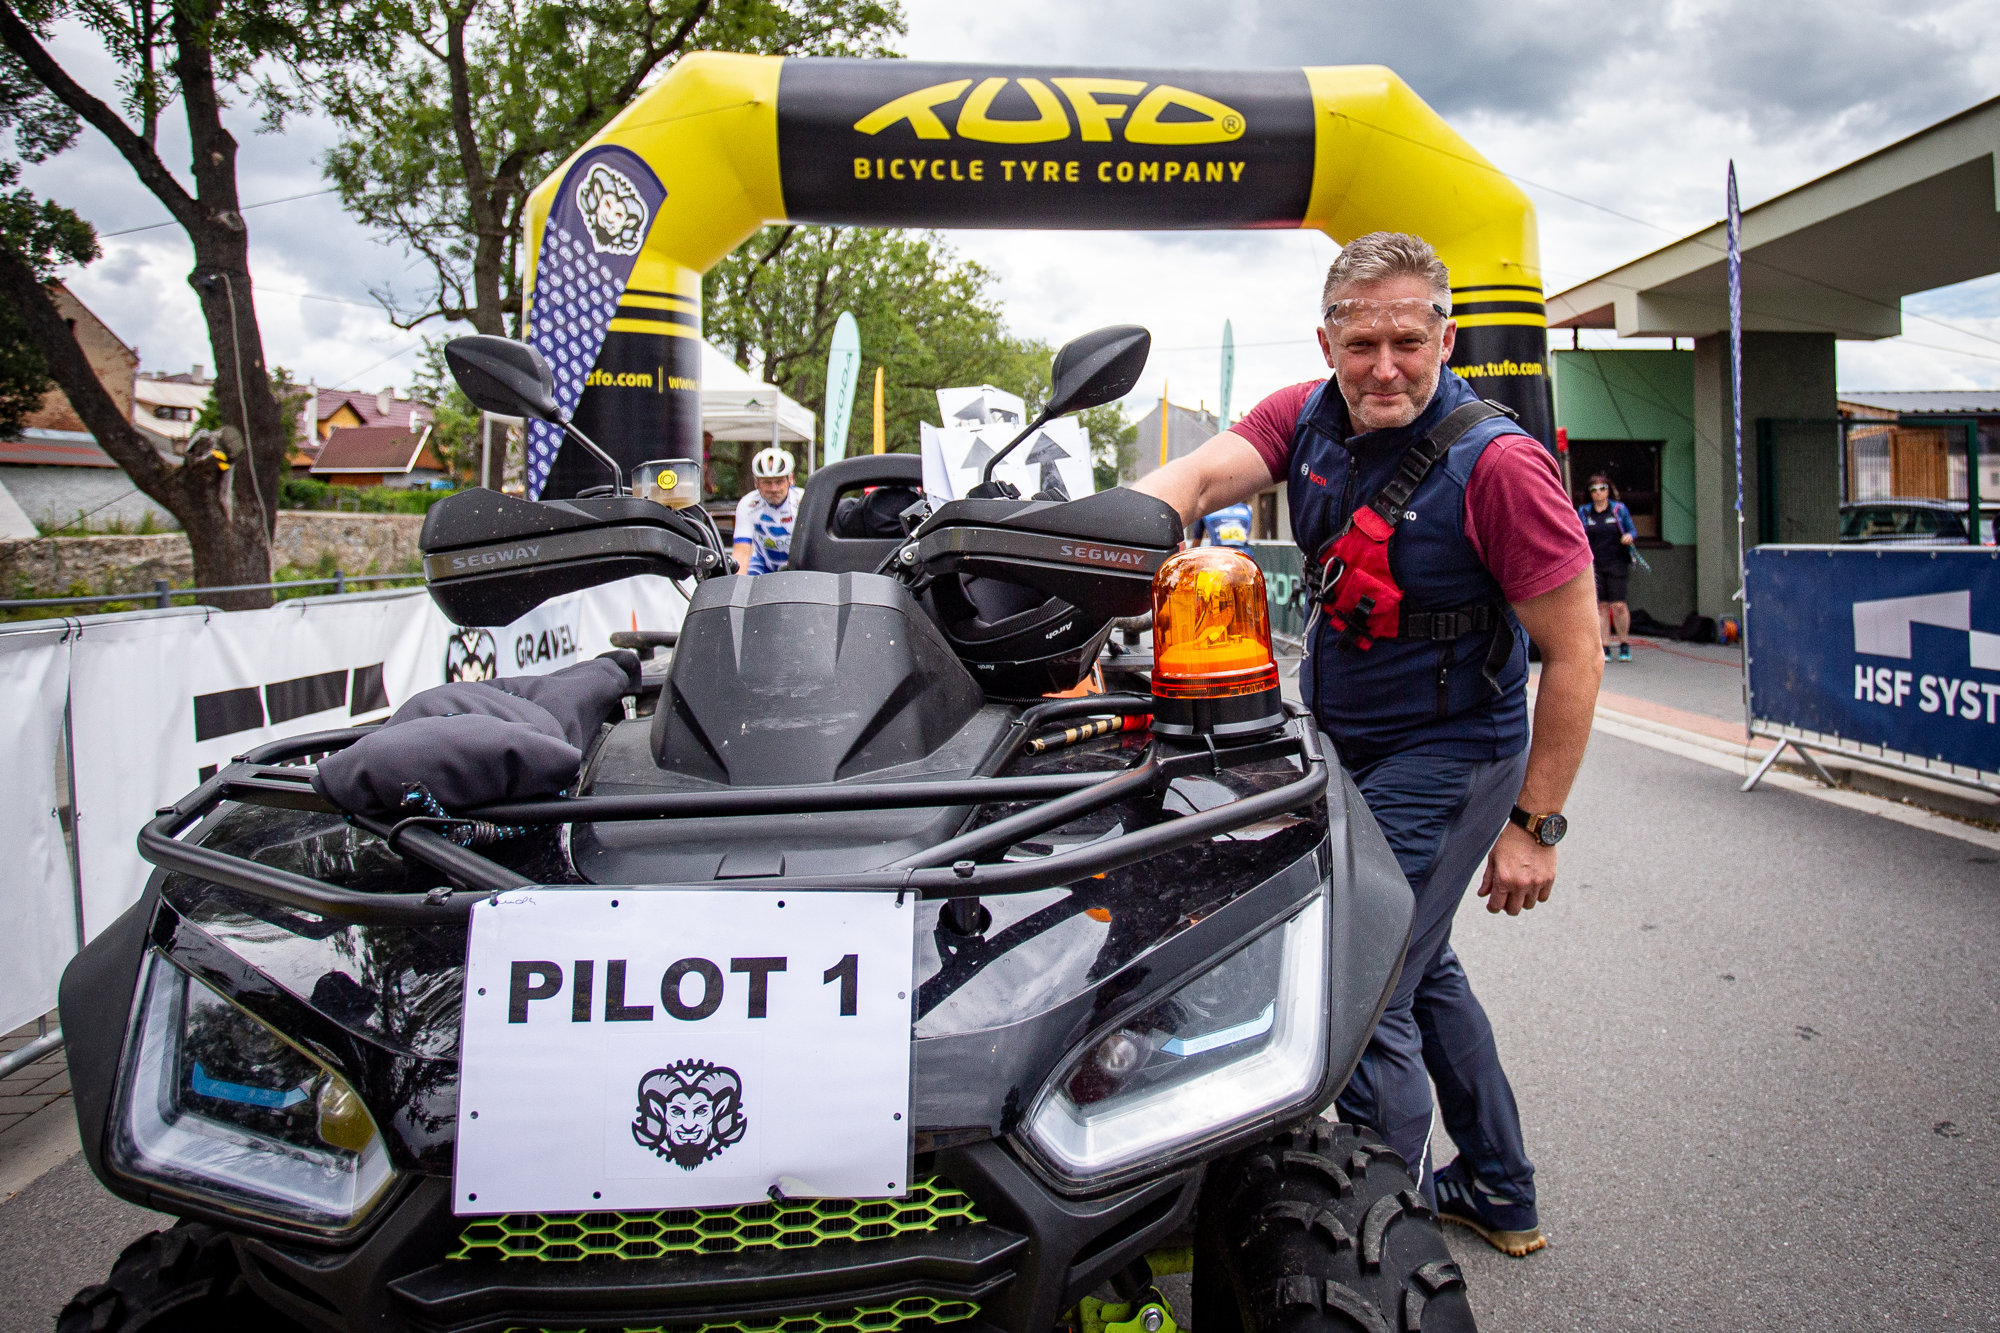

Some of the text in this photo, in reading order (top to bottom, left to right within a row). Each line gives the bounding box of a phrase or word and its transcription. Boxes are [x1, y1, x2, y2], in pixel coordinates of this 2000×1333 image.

[853, 157, 1247, 184] BICYCLE TYRE COMPANY
[452, 545, 540, 569] SEGWAY
[1060, 545, 1145, 565] SEGWAY
[515, 624, 576, 670] GRAVEL
[1854, 663, 1913, 707] HSF
[508, 953, 859, 1025] PILOT 1
